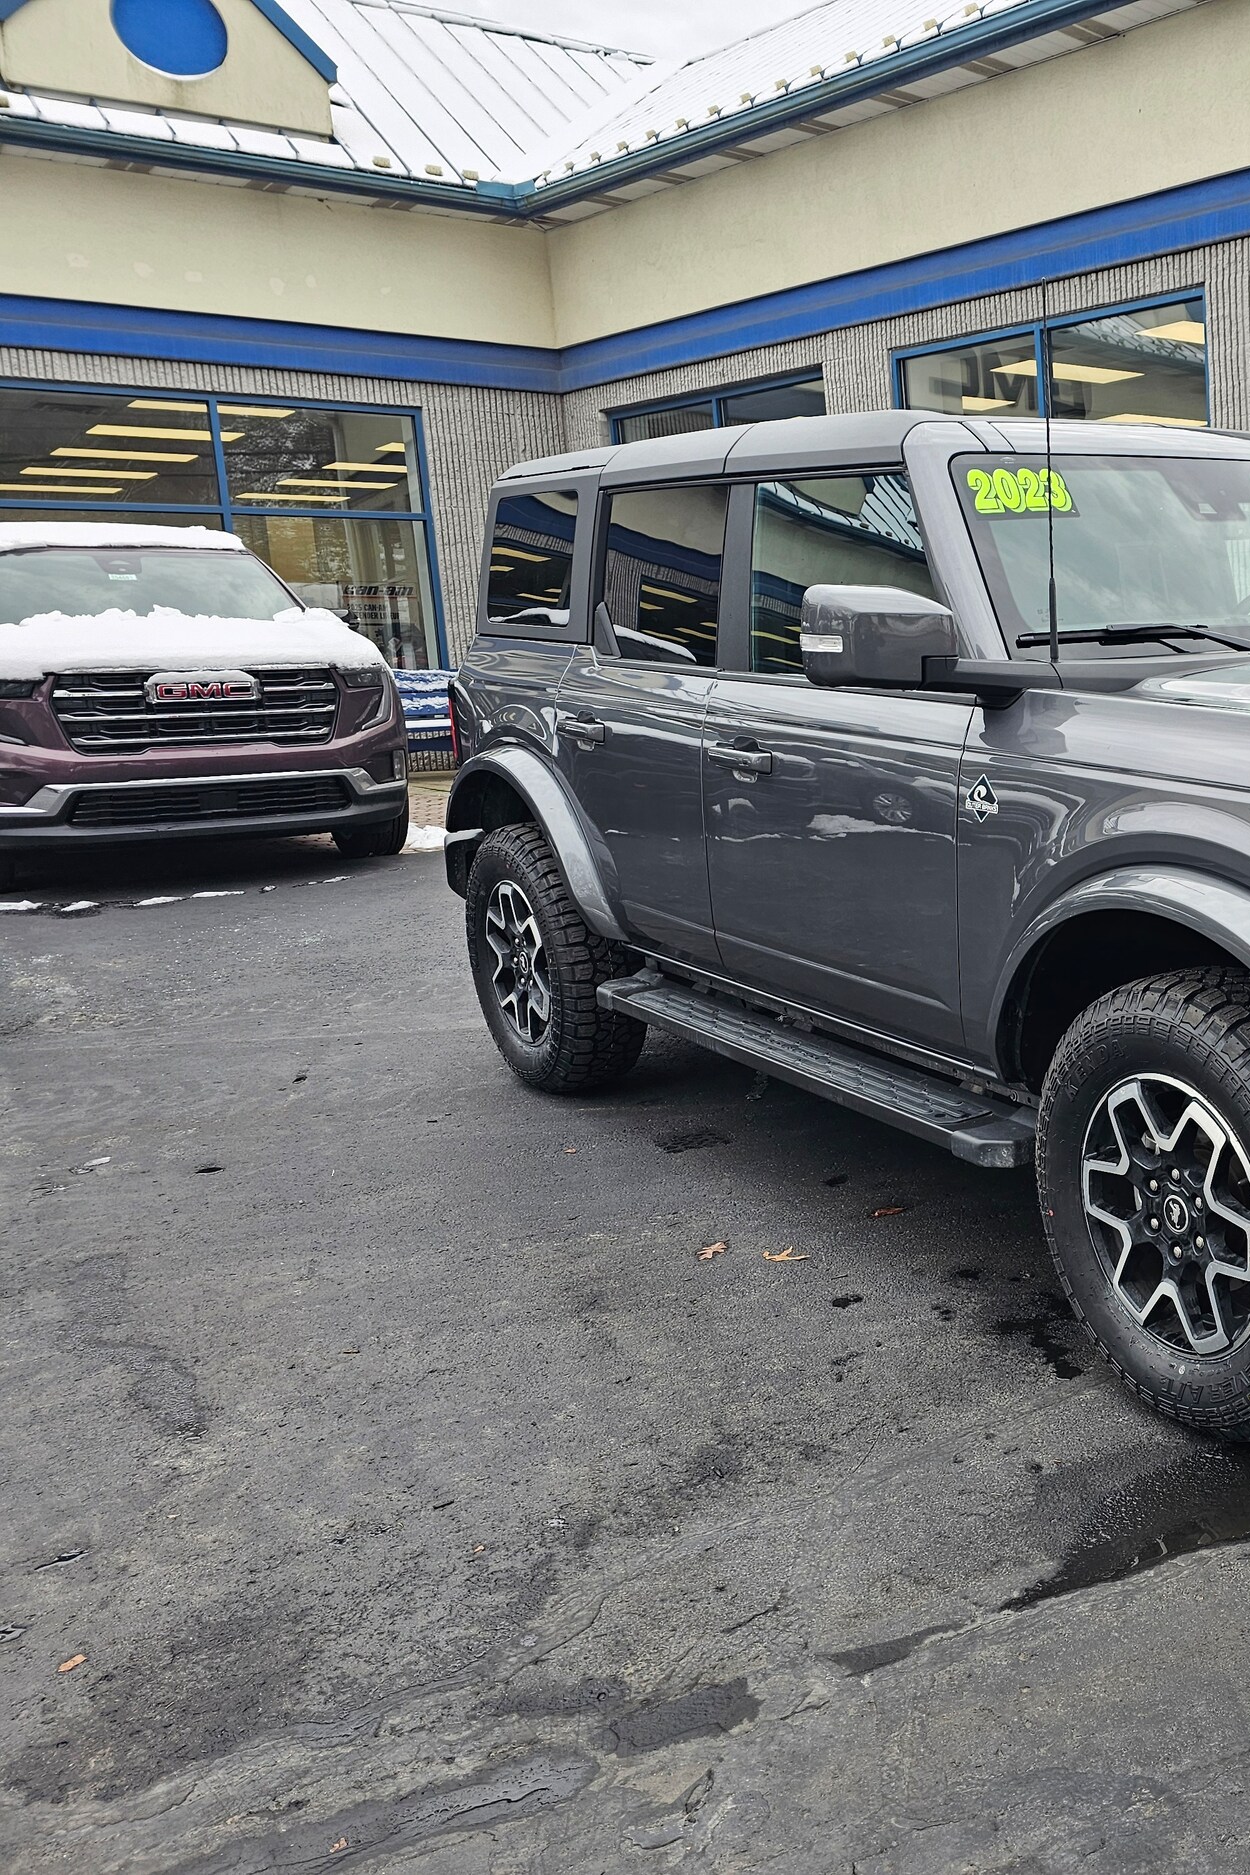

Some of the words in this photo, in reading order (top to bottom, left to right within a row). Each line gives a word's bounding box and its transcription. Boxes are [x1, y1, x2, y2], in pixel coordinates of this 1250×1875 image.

[967, 468, 1073, 514] 2023
[157, 681, 254, 700] GMC
[1064, 1038, 1125, 1103] KENDA
